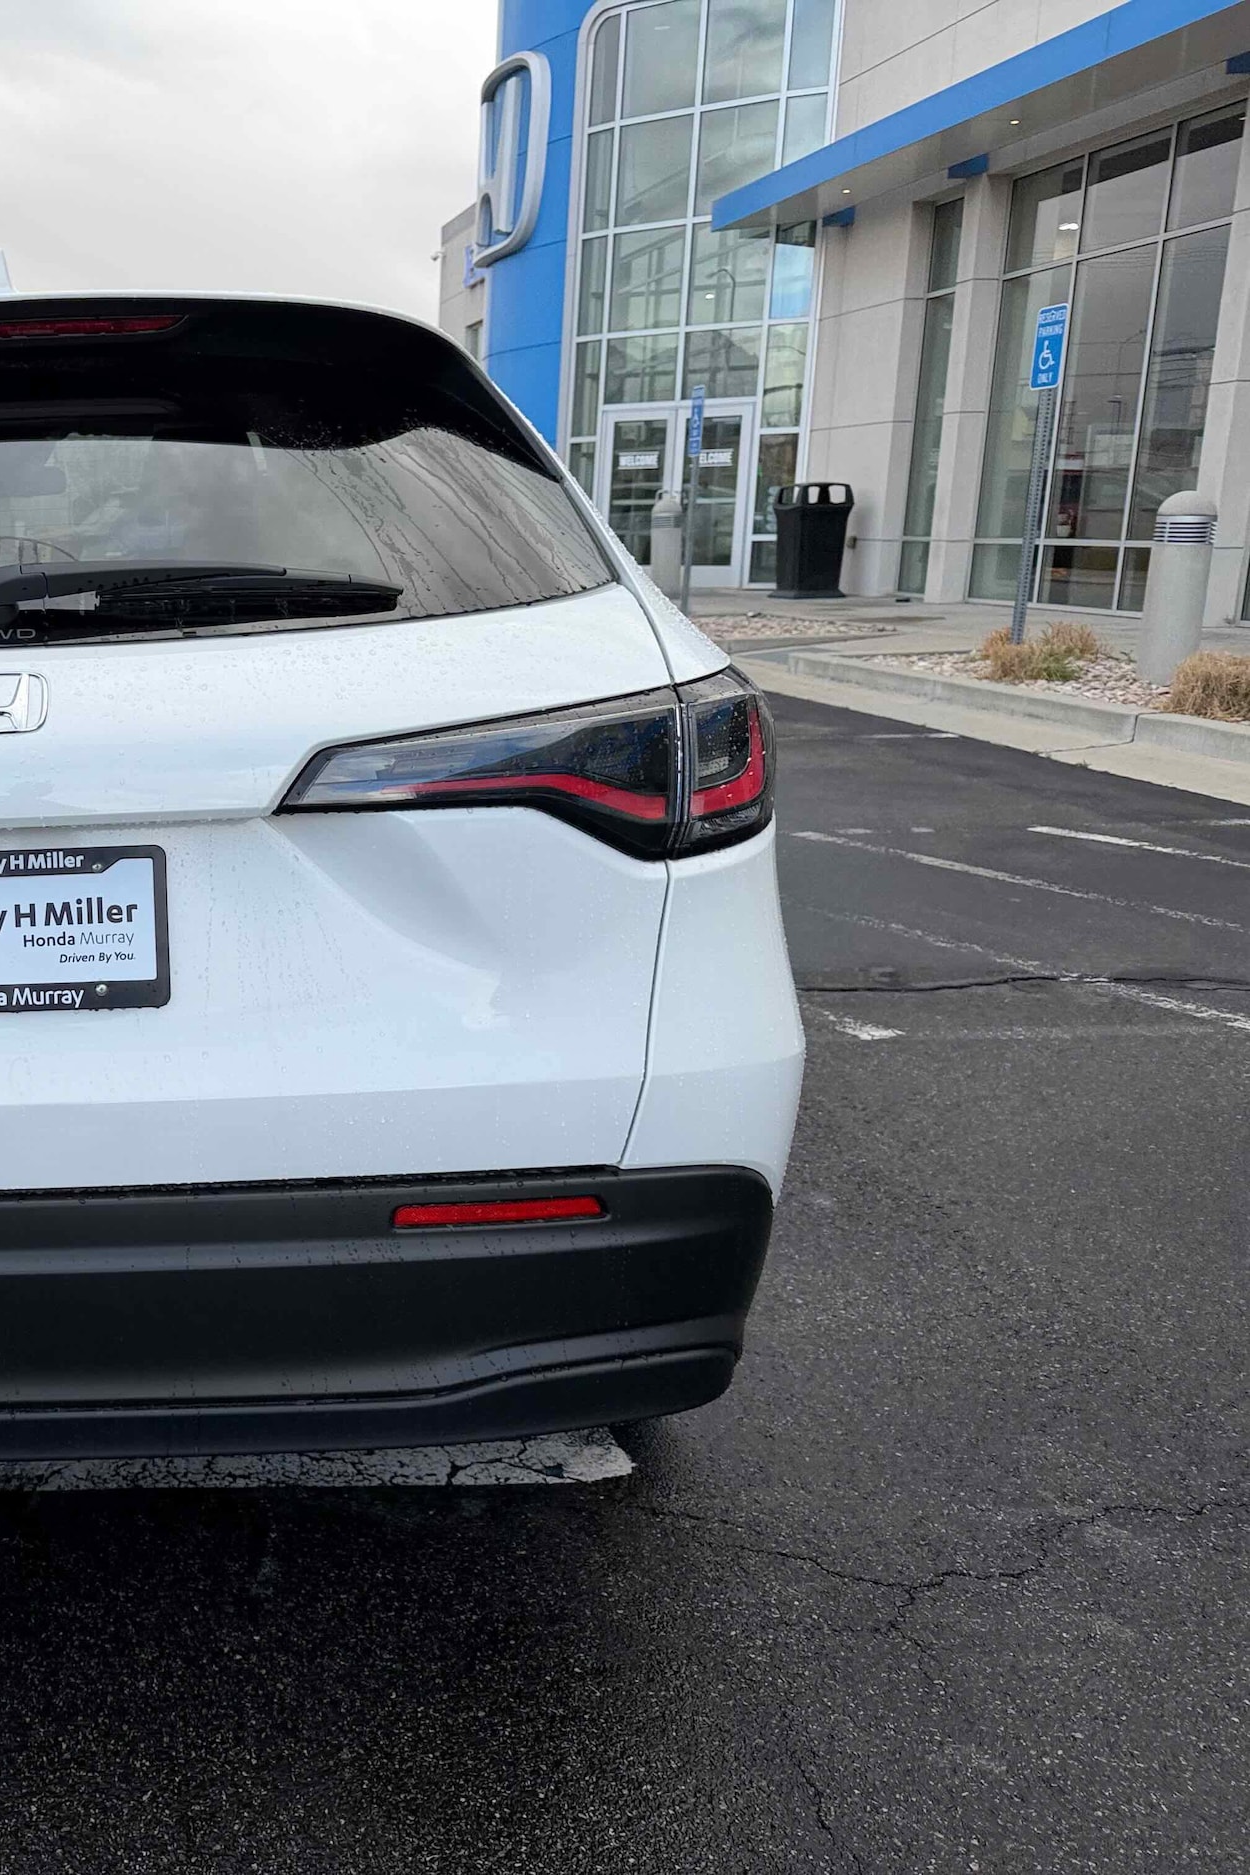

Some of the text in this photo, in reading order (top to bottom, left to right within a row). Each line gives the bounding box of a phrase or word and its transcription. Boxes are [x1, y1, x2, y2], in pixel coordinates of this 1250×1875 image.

[1039, 310, 1066, 323] RESERVED
[1038, 324, 1063, 337] PARKING
[1037, 372, 1053, 384] ONLY
[619, 454, 658, 467] WELCOME
[699, 451, 732, 464] ELCOME
[9, 855, 25, 870] H
[27, 851, 84, 869] Miller
[14, 904, 36, 928] H
[44, 897, 138, 926] Miller
[23, 931, 135, 947] Honda Murray
[59, 953, 95, 964] Driven
[98, 952, 112, 964] By
[11, 987, 85, 1008] Murray
